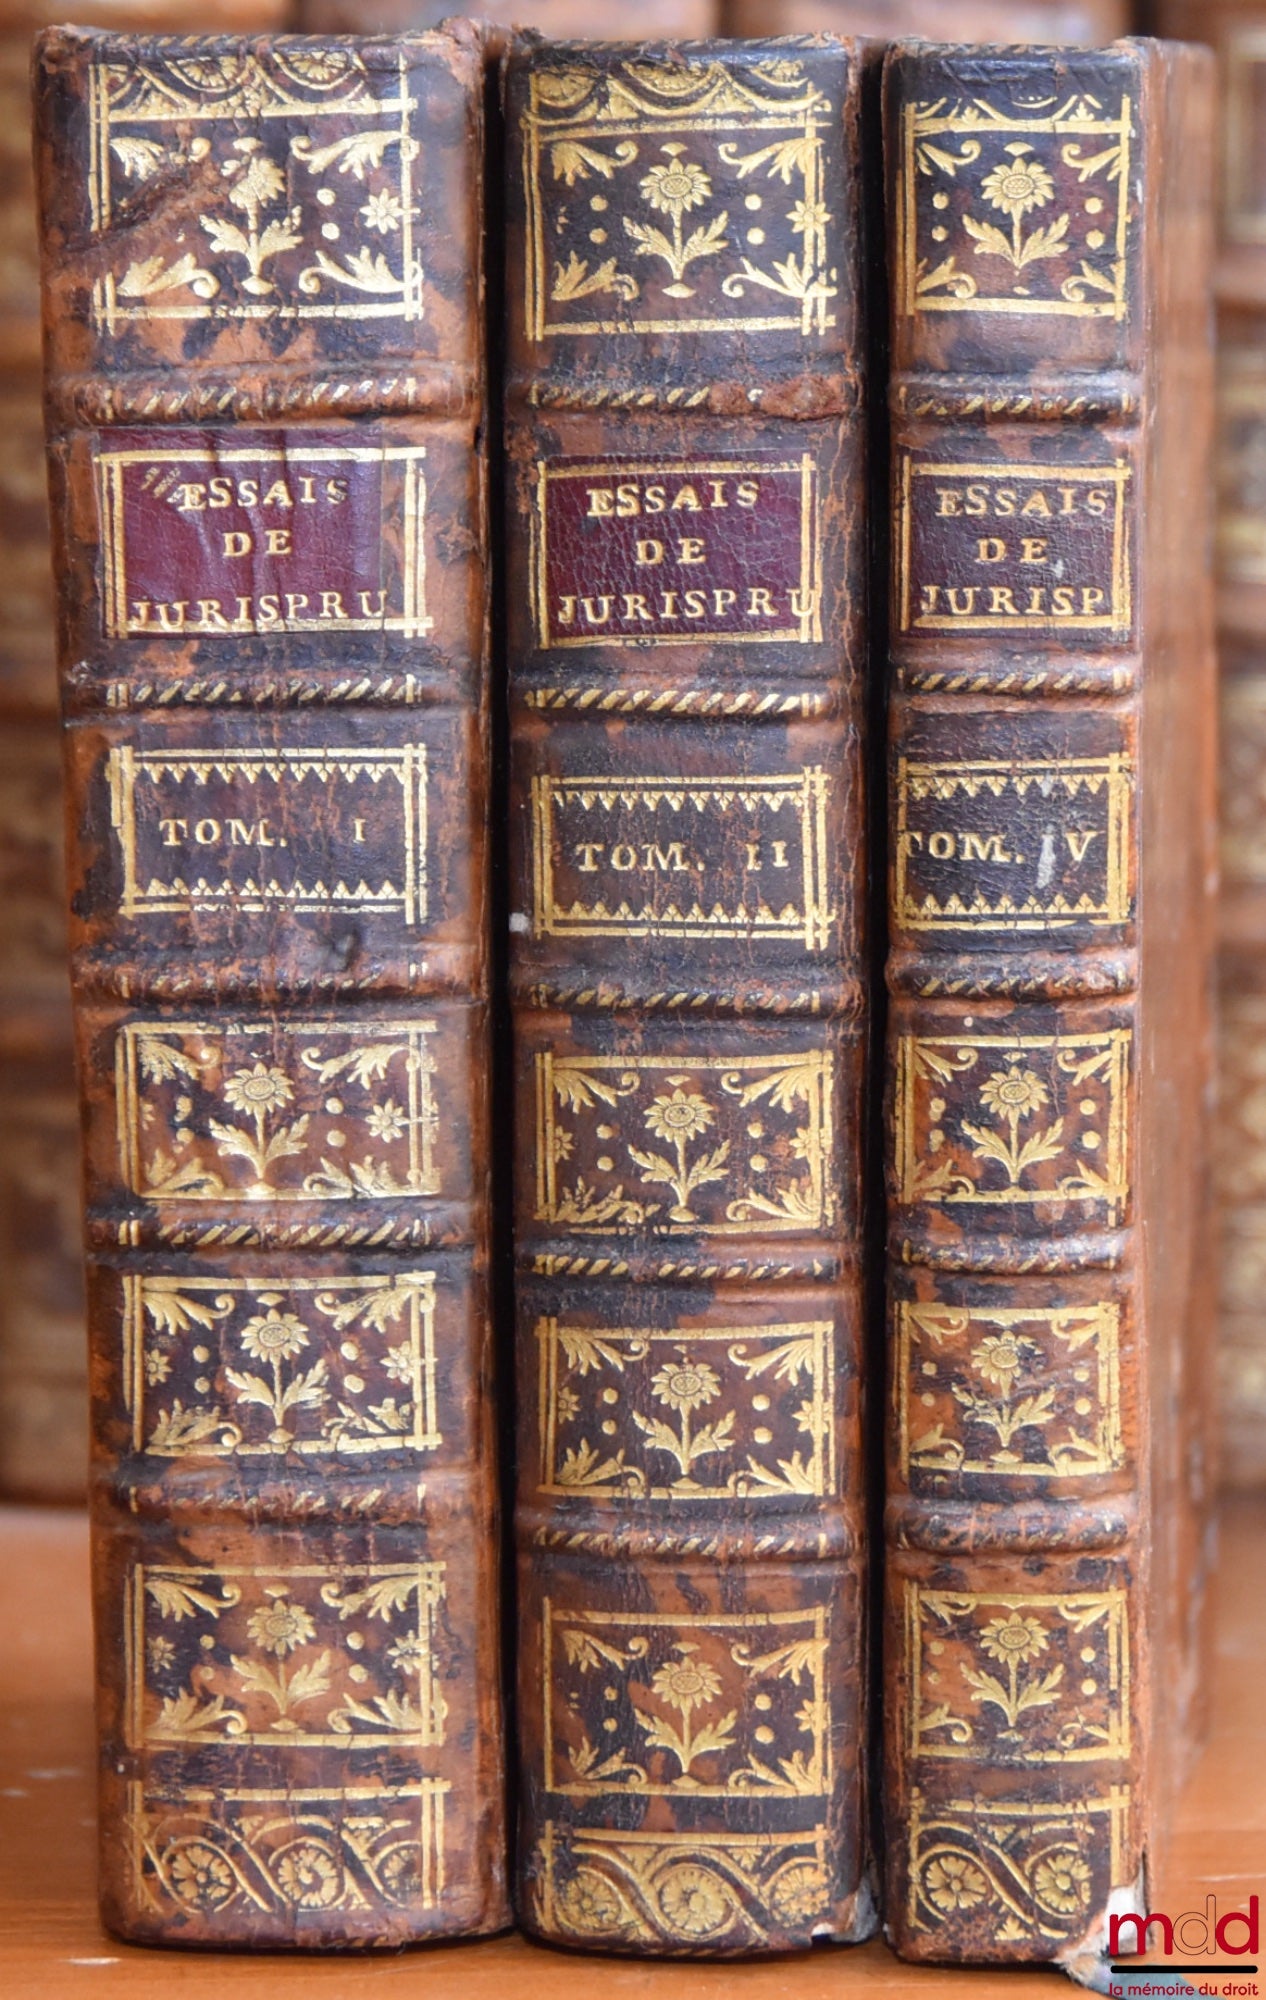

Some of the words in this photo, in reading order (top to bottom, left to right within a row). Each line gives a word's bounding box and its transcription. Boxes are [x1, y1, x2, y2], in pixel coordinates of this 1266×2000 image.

[176, 475, 349, 513] ESSAIS
[586, 479, 760, 518] ESSAIS
[935, 483, 1110, 518] ESSAIS
[222, 528, 293, 558] DE
[635, 537, 707, 566] DE
[974, 537, 1049, 564] DE
[130, 589, 388, 632] JURISPRU
[557, 586, 817, 625] JURISPRU
[919, 584, 1105, 616] JURISP
[158, 817, 289, 848] TOM.
[352, 817, 367, 844] I
[574, 840, 706, 873] TOM.
[745, 840, 790, 872] II
